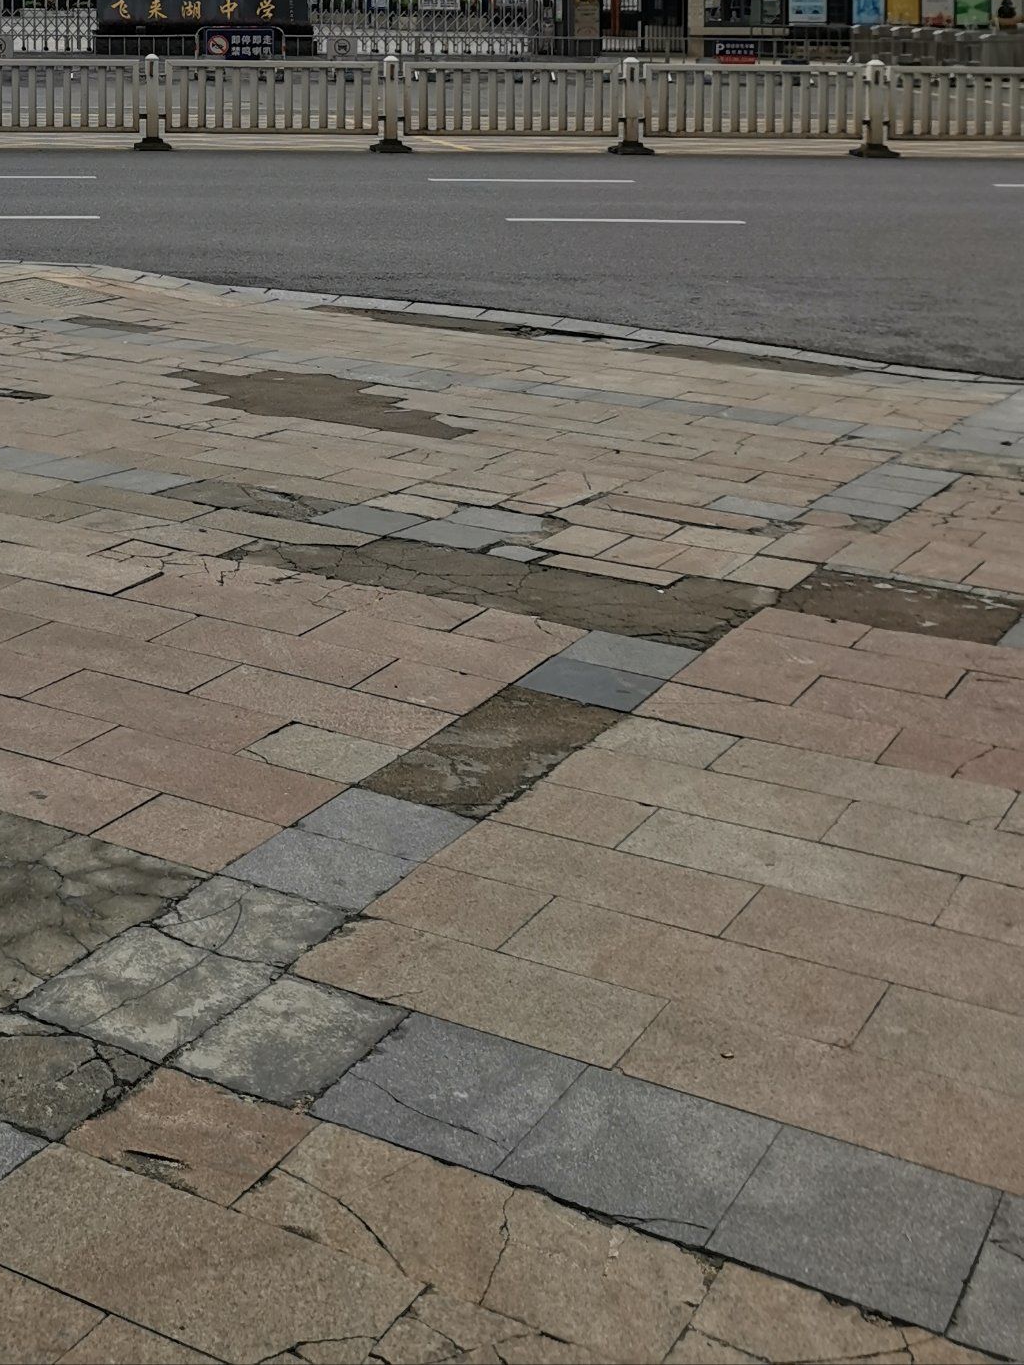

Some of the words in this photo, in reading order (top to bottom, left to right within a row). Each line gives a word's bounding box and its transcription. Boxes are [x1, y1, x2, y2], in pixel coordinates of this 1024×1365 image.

[231, 35, 272, 45] 即停即走
[231, 46, 273, 56] 禁鸣喇叭
